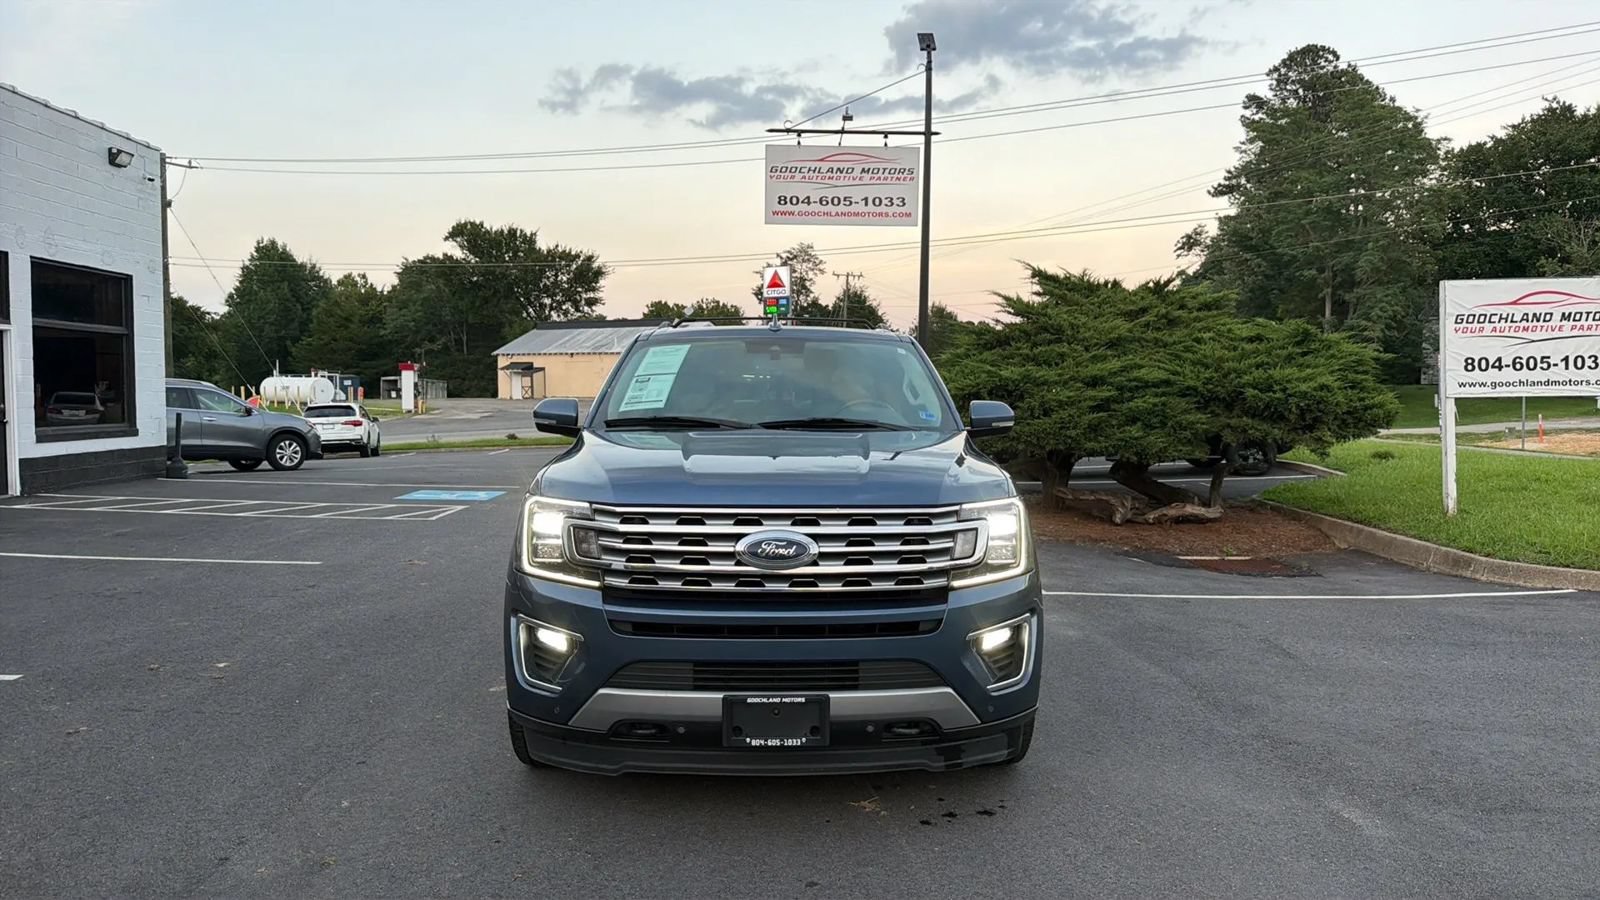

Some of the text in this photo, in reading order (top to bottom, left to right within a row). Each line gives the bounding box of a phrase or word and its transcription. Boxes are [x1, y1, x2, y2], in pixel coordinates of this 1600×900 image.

[769, 165, 915, 176] GOOCHLAND MOTORS
[799, 174, 865, 182] AUTOMOTIVE
[777, 194, 907, 207] 804-605-1033
[771, 210, 912, 218] WWW.GOOCHLANDMOTORS.COM
[766, 288, 787, 296] CITGO
[1454, 312, 1554, 325] GOOCHLAND
[1453, 325, 1485, 334] YOUR
[1490, 324, 1565, 333] AUTOMOTIVE
[1463, 354, 1600, 373] 804-605-103
[757, 540, 797, 557] Ford
[750, 738, 801, 747] 804-605-1033
